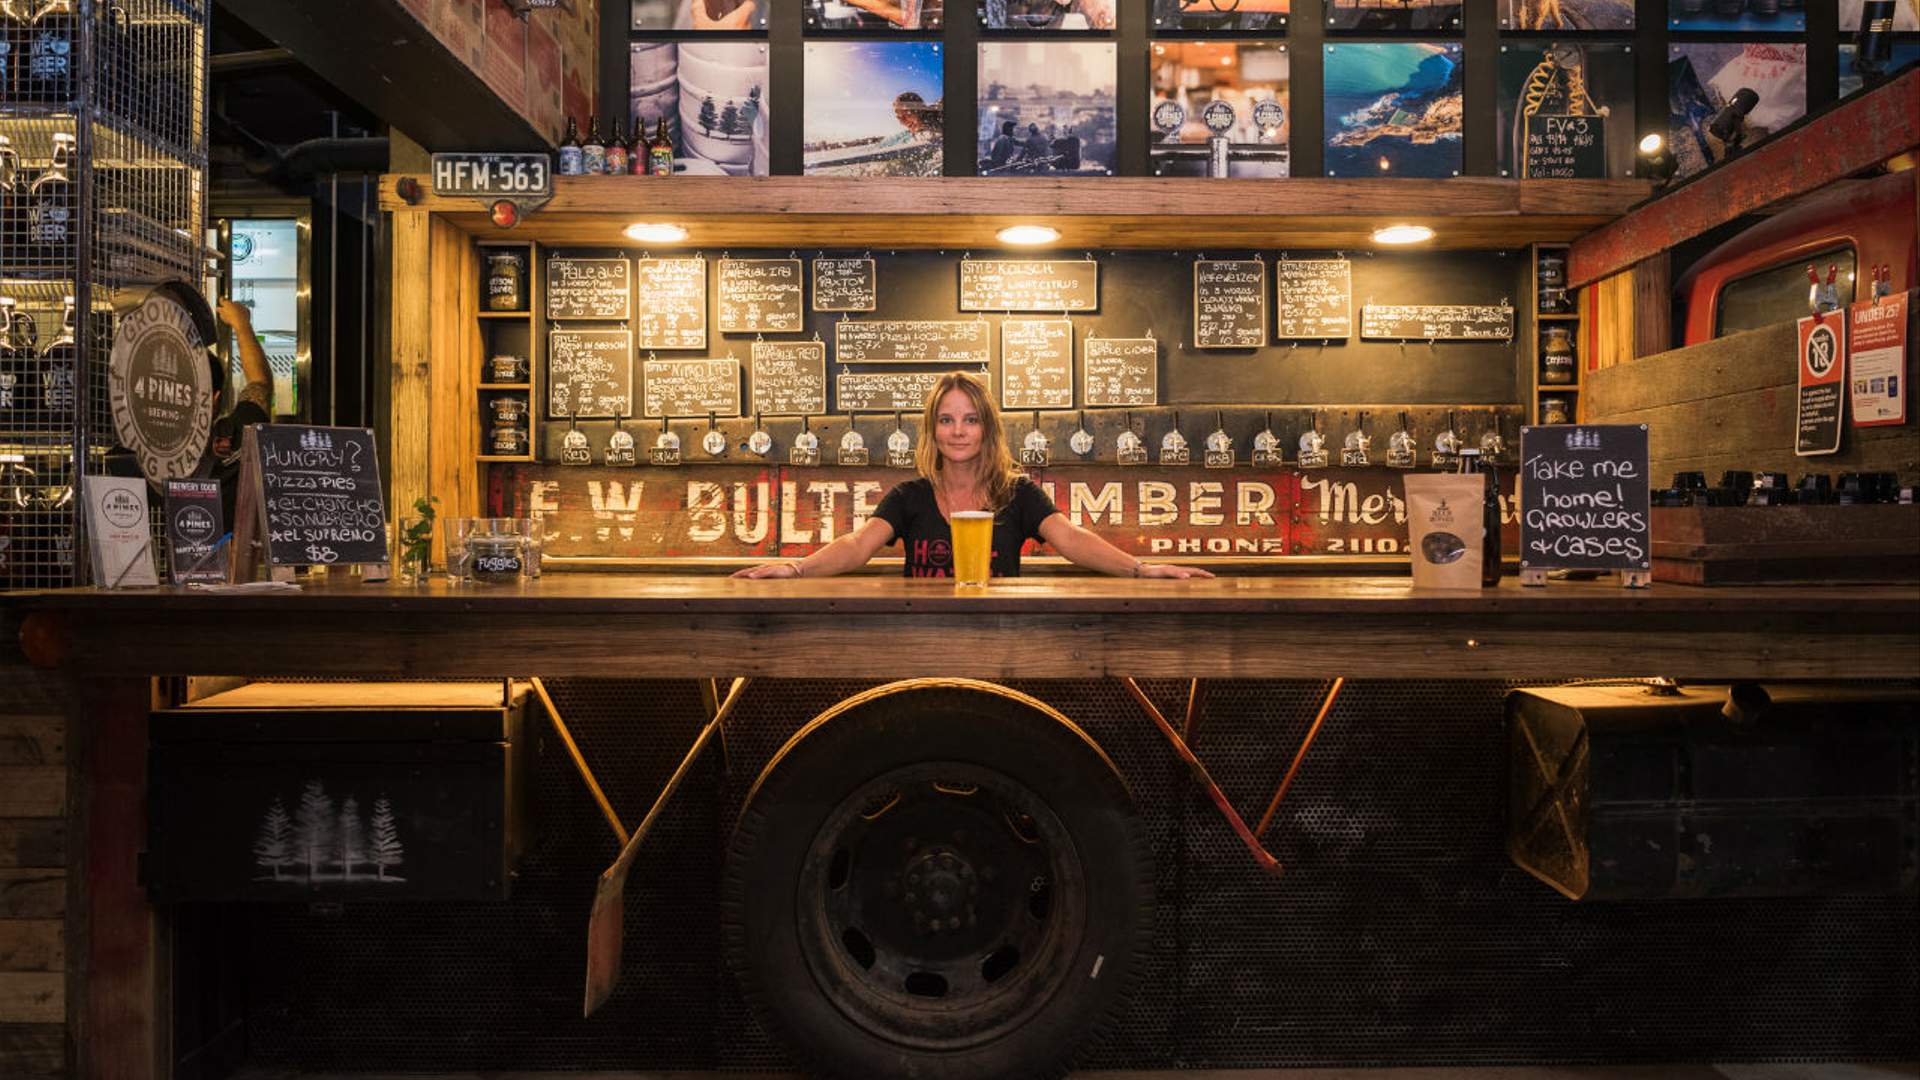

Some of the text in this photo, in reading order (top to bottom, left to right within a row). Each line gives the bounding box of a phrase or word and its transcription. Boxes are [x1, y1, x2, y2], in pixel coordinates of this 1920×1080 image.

[1855, 307, 1885, 325] UNDER
[134, 375, 192, 408] 4 PINES
[1524, 453, 1638, 480] Take me
[1542, 483, 1624, 509] home!
[305, 544, 340, 562] $8
[1150, 537, 1285, 553] PHONE
